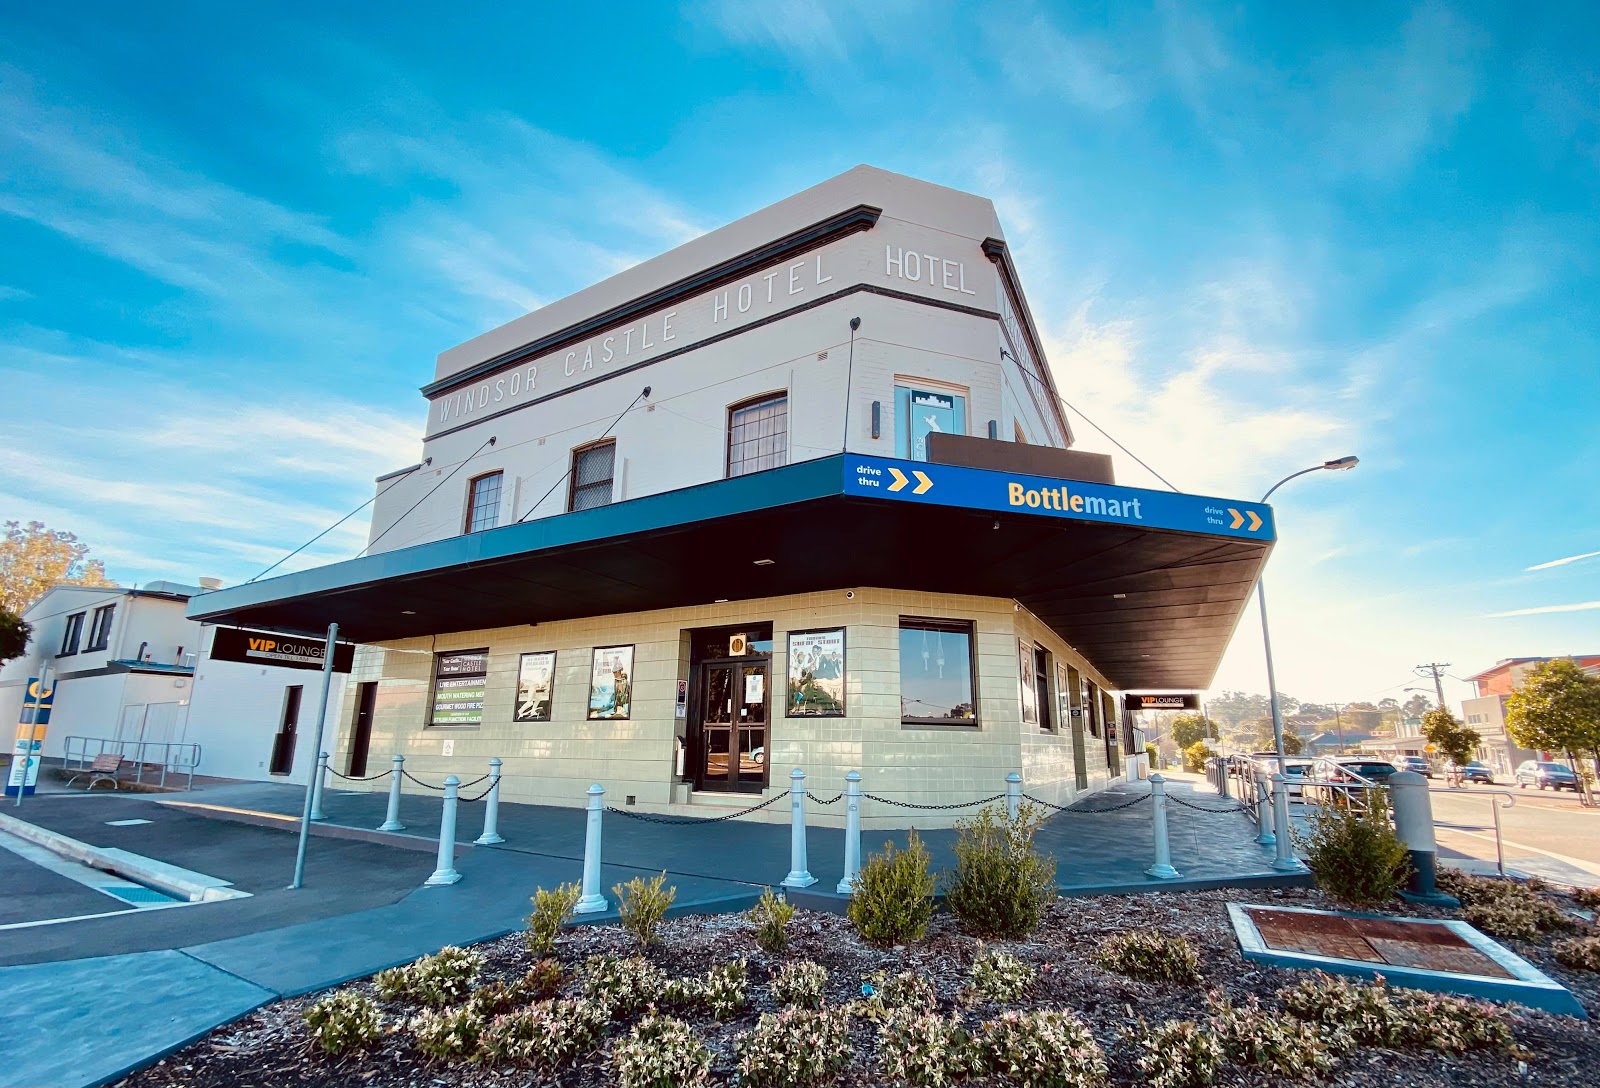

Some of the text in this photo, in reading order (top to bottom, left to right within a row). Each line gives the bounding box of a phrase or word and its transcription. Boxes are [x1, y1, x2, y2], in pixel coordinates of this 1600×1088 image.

[886, 244, 976, 295] HOTEL
[439, 254, 833, 424] WINDSOR CASTLE HOTEL
[856, 465, 882, 476] drive
[857, 477, 880, 487] thru
[1008, 482, 1143, 520] Bottlemart
[1204, 505, 1224, 516] drive
[1206, 516, 1224, 526] thru
[249, 638, 275, 651] VIP
[437, 692, 452, 700] MOUTH
